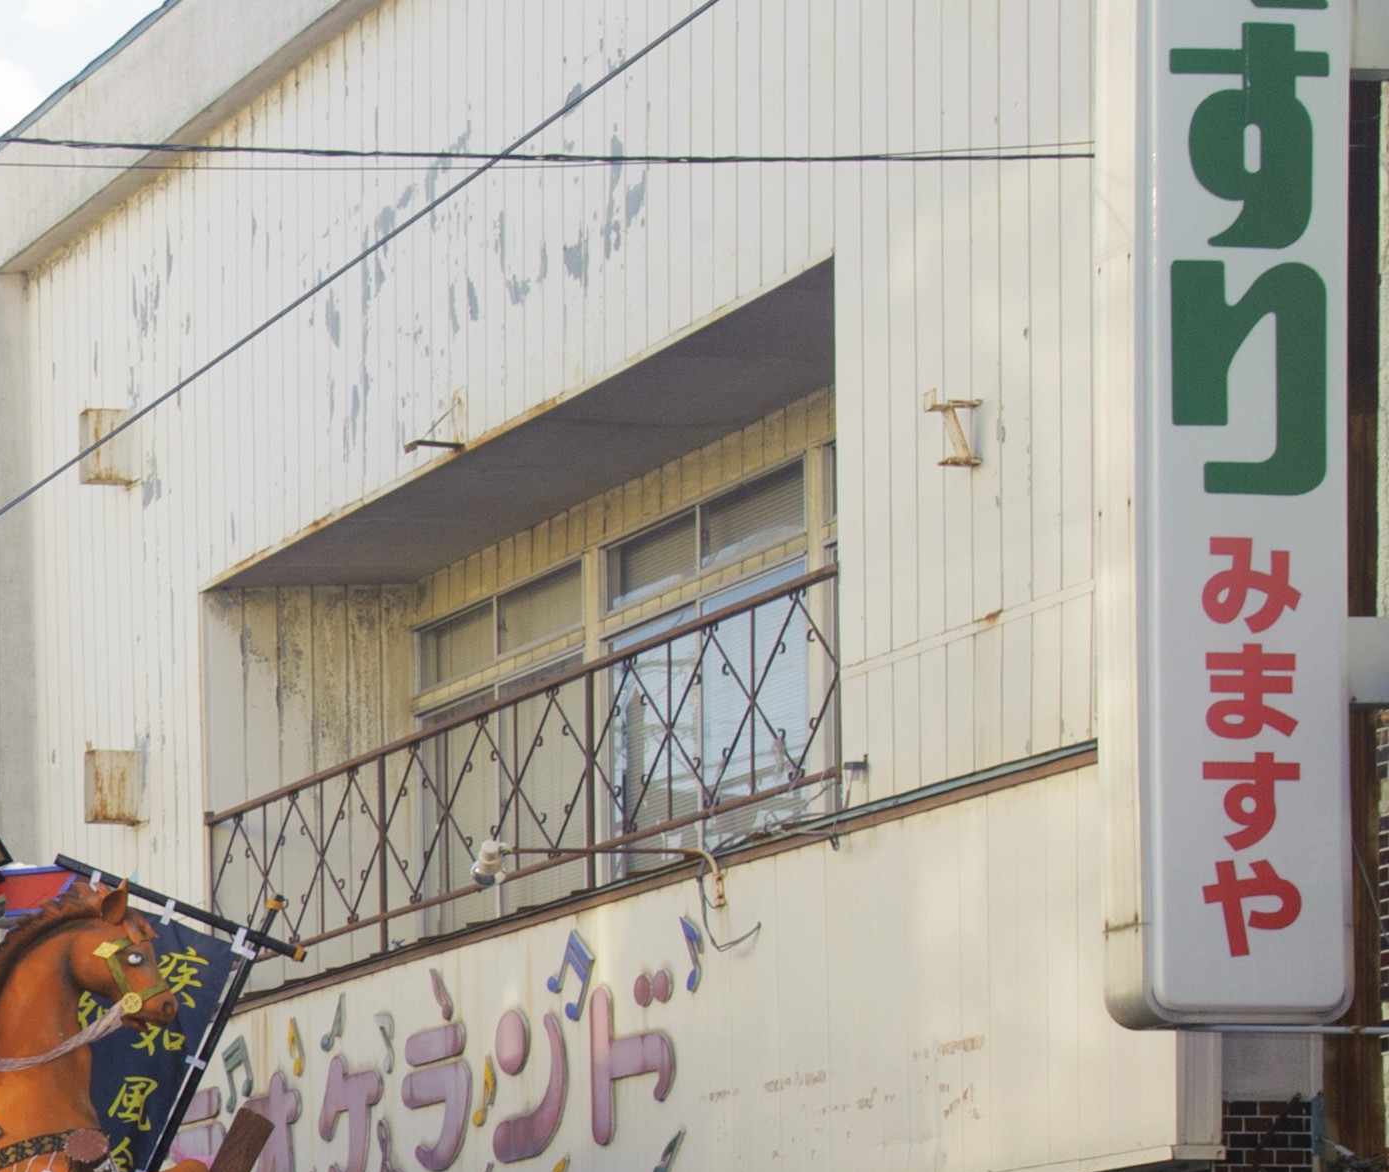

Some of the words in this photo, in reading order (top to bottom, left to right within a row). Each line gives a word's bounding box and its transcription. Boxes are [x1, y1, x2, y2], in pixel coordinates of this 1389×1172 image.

[1170, 0, 1330, 497] すり
[1200, 537, 1302, 958] みますや
